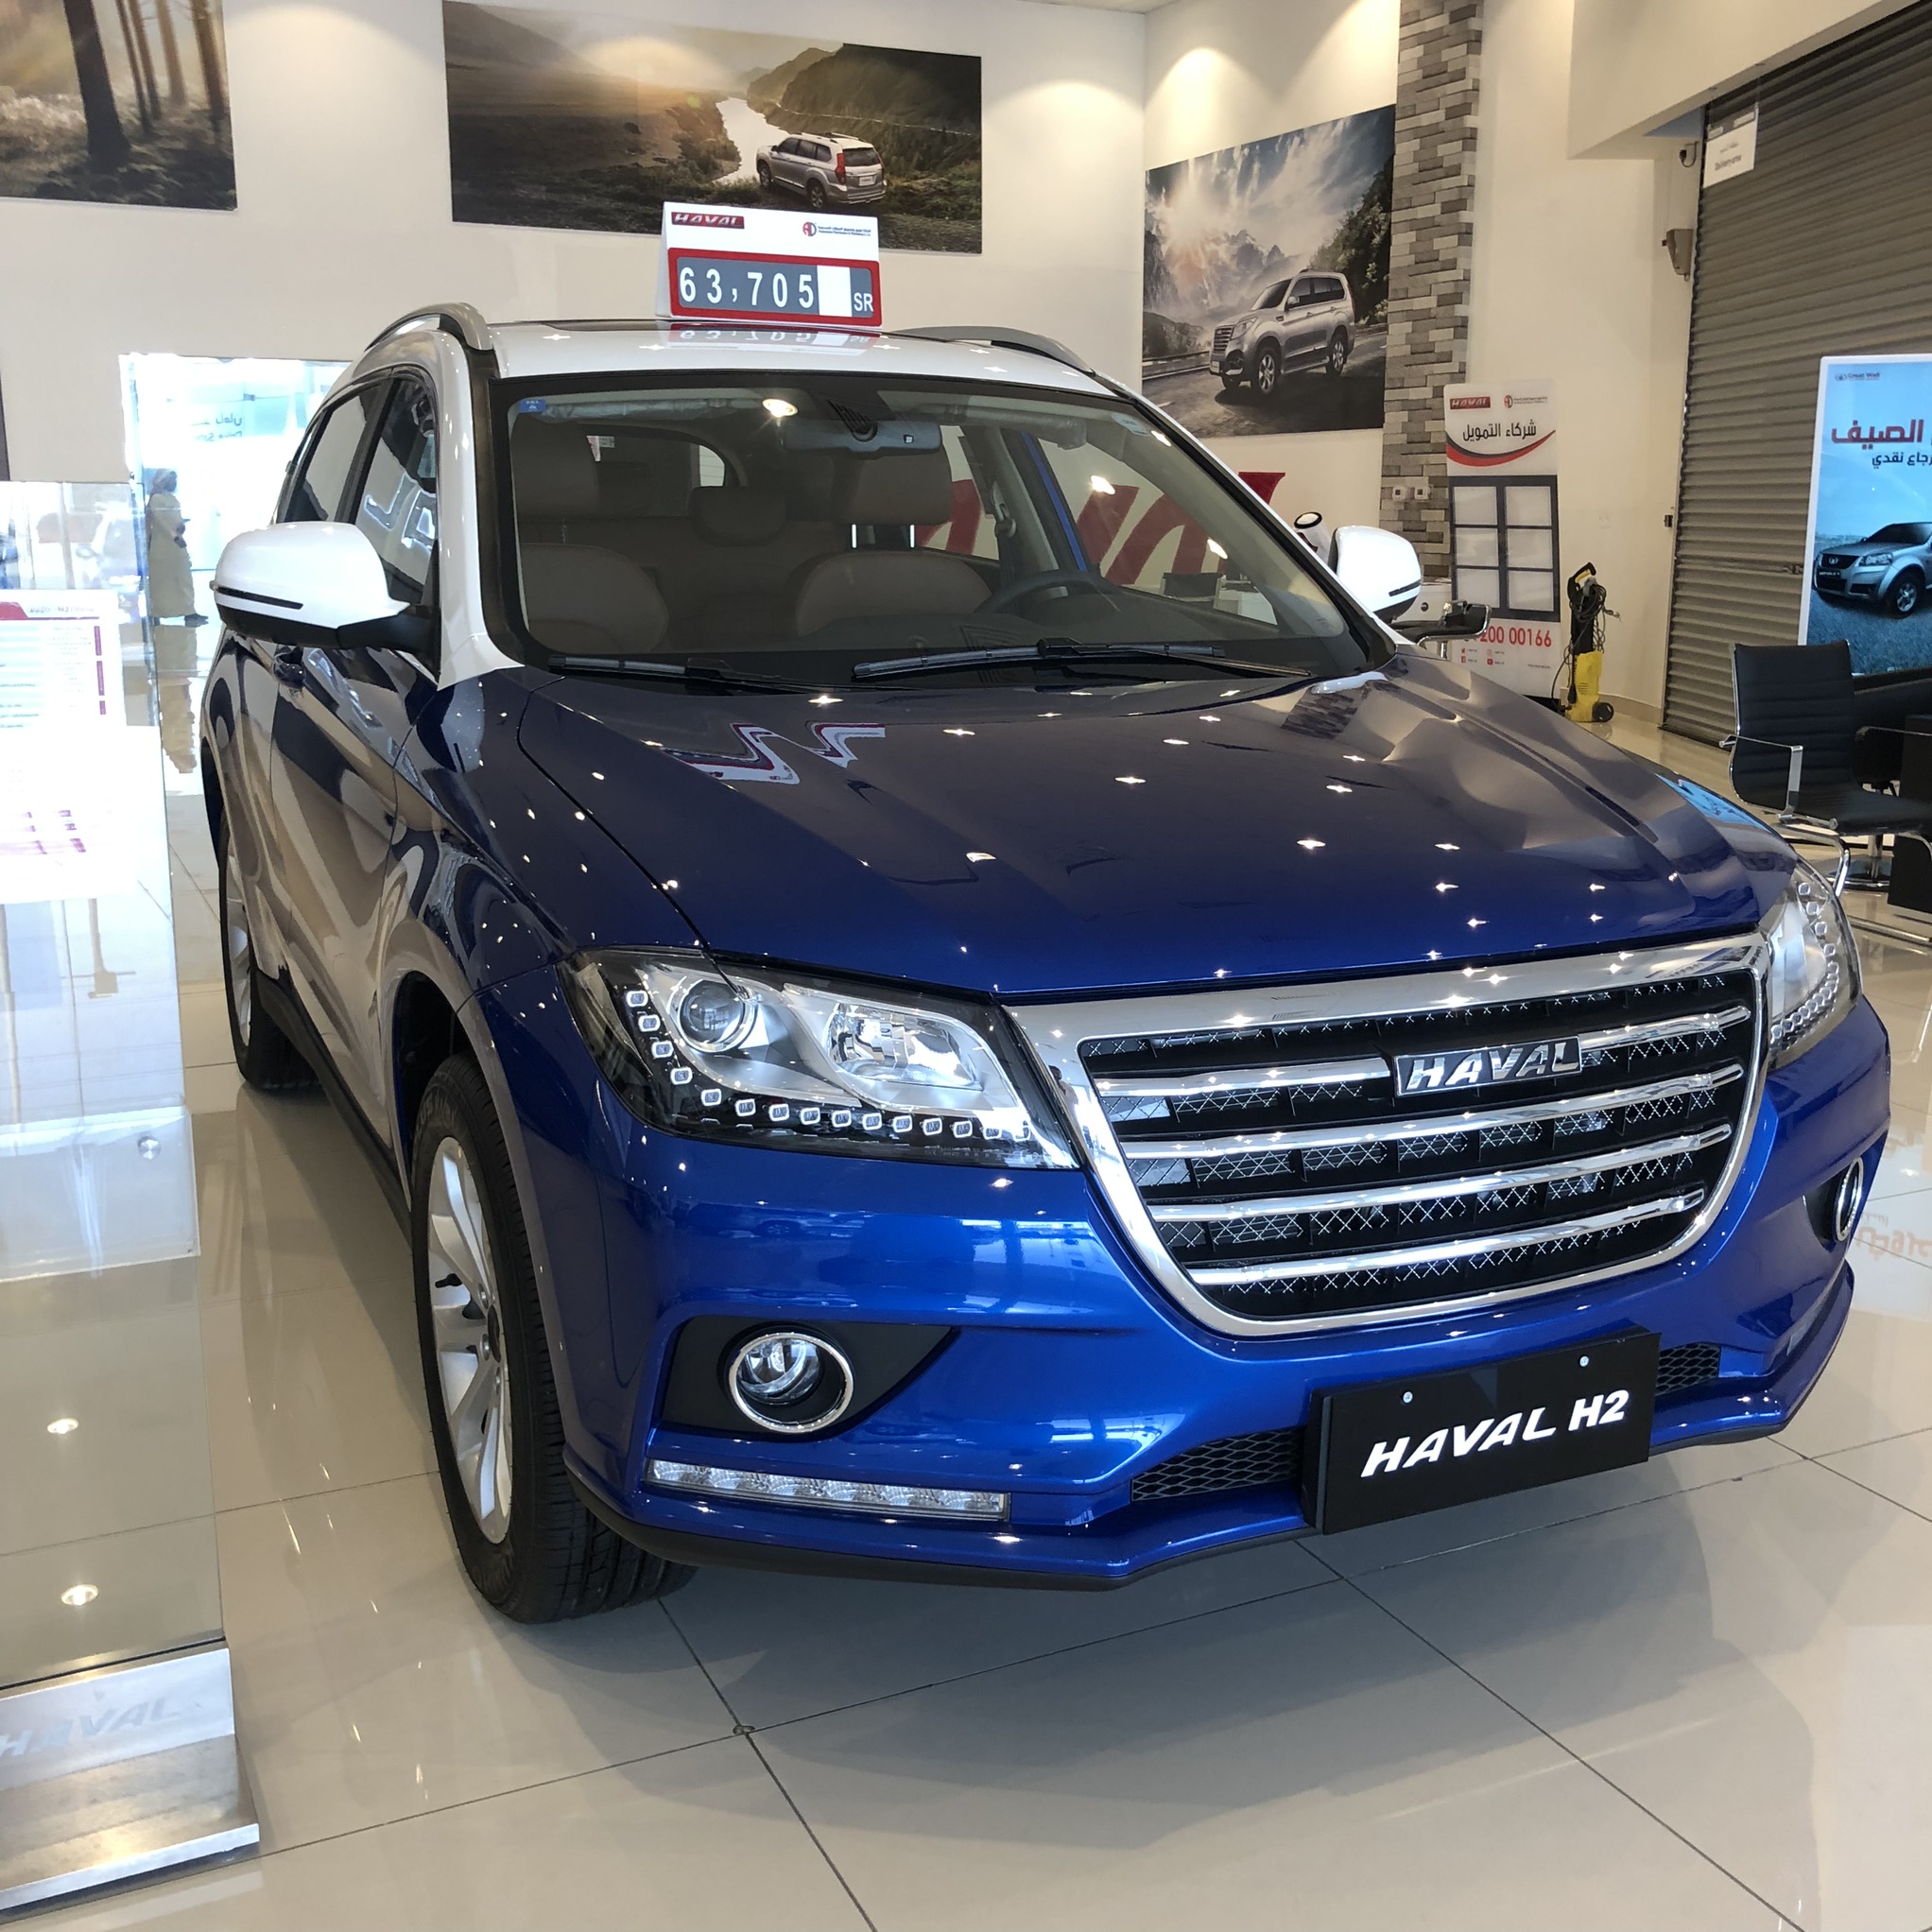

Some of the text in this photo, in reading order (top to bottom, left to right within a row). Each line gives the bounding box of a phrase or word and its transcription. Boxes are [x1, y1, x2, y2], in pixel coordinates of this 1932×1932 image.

[674, 213, 743, 228] HAVAL
[680, 267, 873, 312] 63,705 SR
[1451, 397, 1487, 408] HAVAL
[1463, 419, 1537, 441] شركاء التمويل
[1831, 419, 1924, 451] الصيف
[1872, 452, 1904, 469] نقدي
[1509, 627, 1552, 647] 00166
[1406, 1042, 1578, 1091] HAVAL
[1360, 1389, 1630, 1478] HAVAL H2
